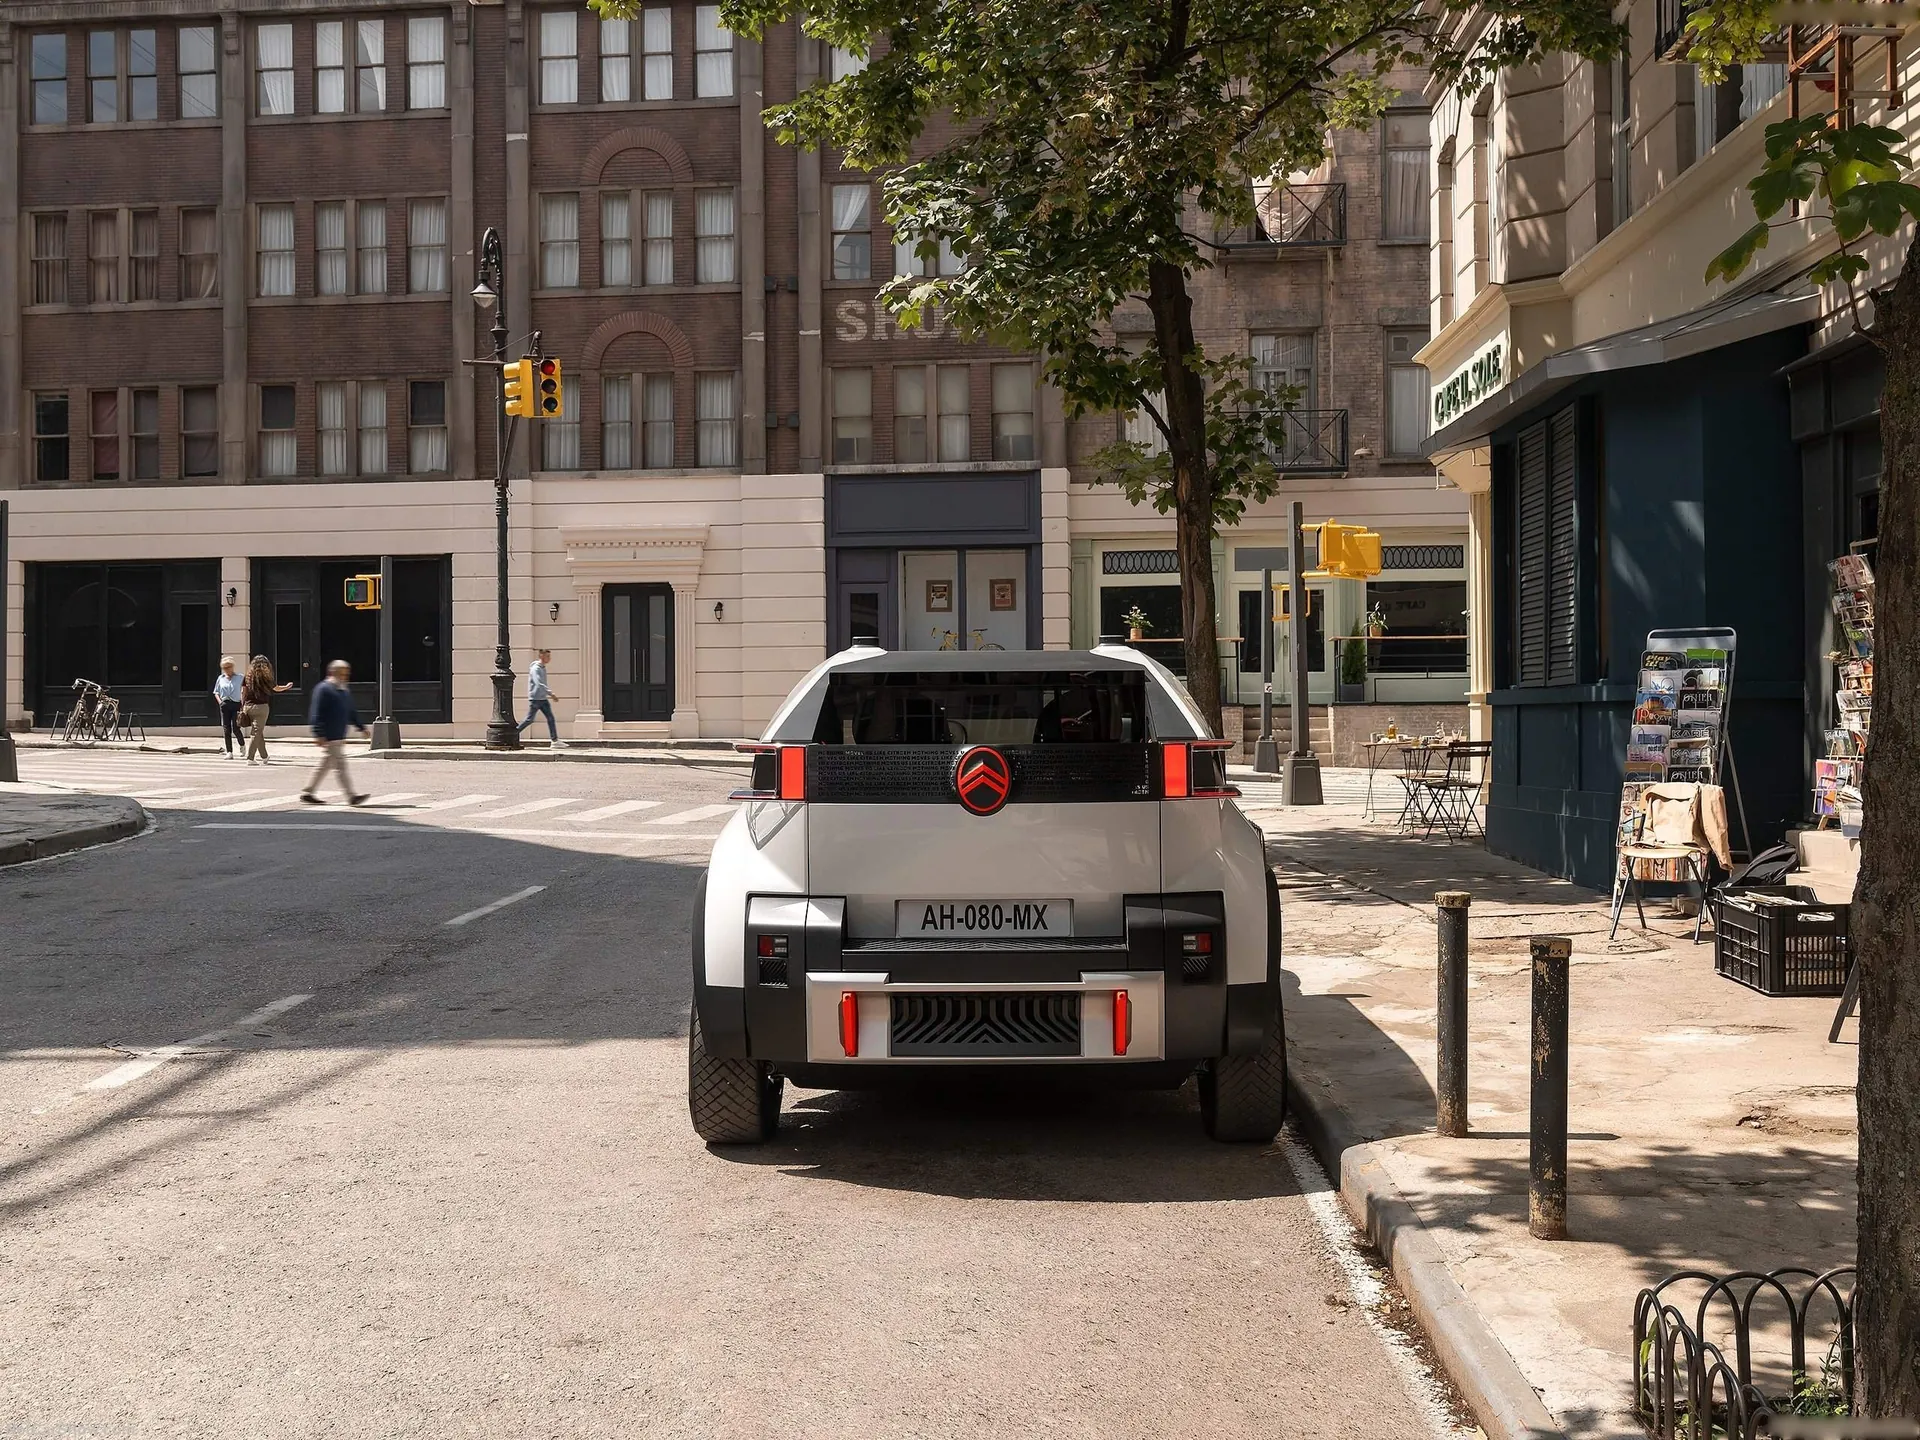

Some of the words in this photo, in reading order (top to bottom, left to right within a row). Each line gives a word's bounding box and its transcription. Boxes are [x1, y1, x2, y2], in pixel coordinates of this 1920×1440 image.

[1472, 344, 1501, 400] SOLE
[1672, 729, 1710, 738] KARE
[921, 904, 1048, 931] AH-080-MX
